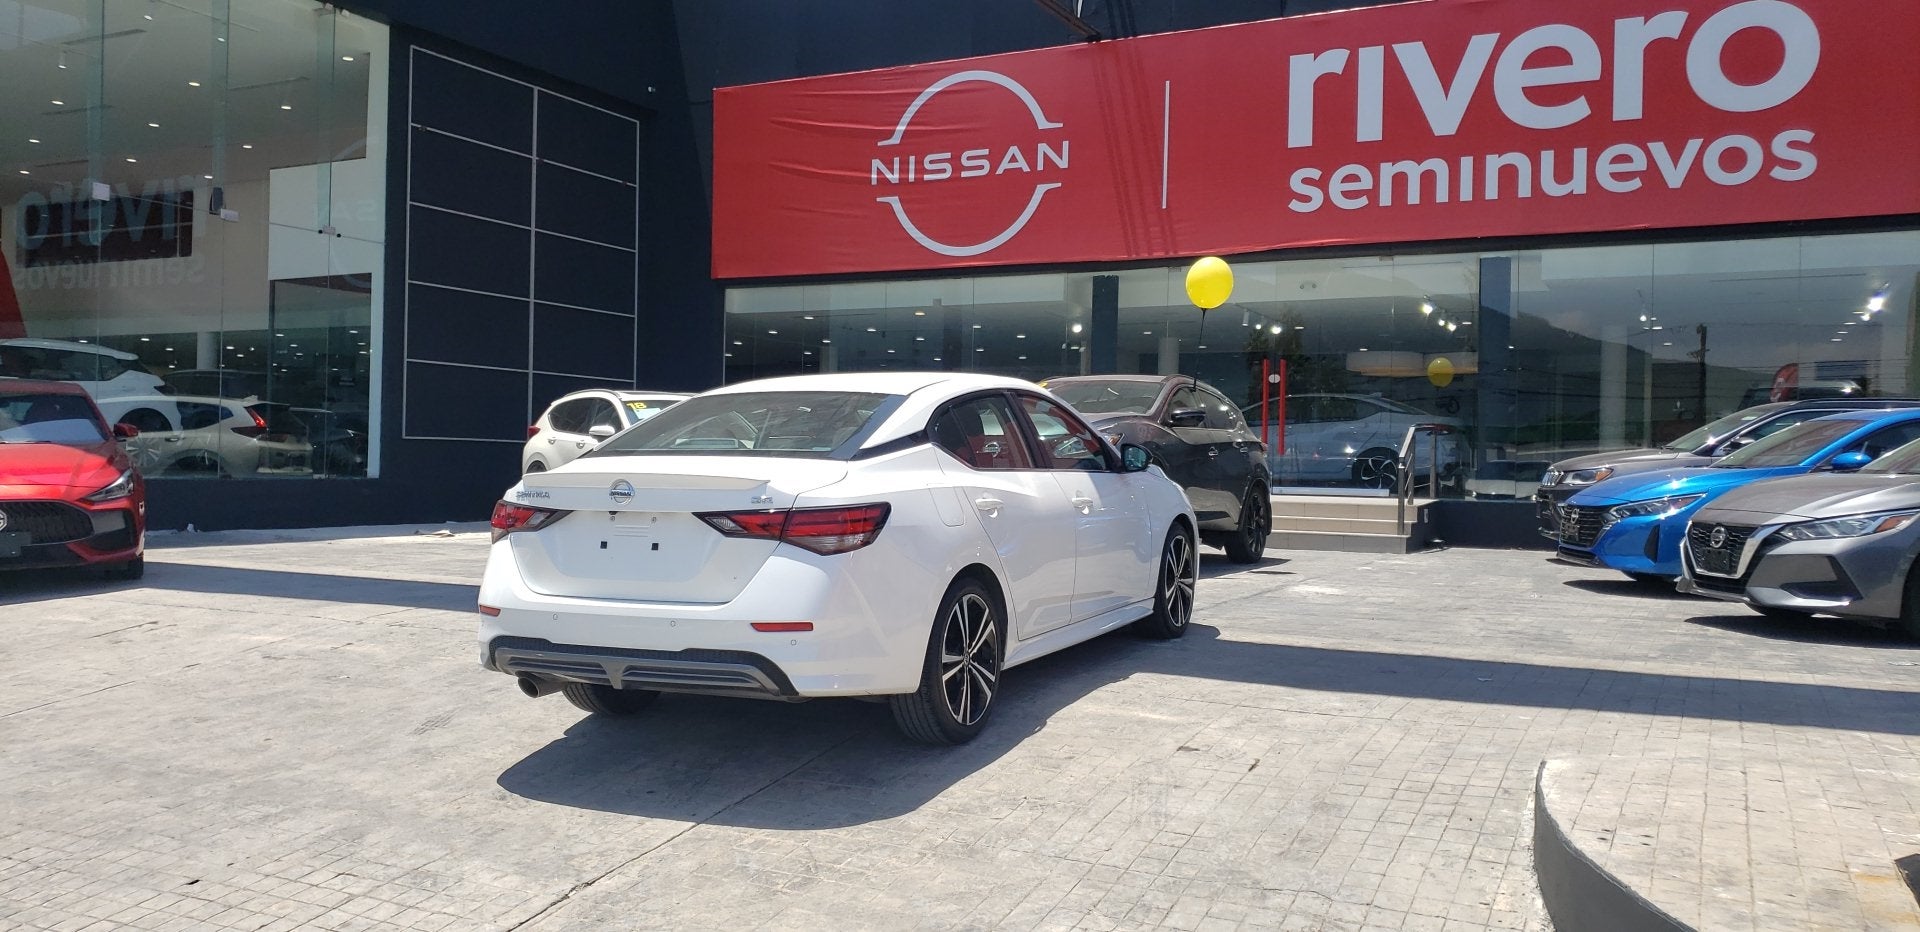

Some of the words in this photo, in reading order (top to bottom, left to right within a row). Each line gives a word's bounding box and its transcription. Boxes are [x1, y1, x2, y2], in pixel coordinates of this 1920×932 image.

[1287, 0, 1821, 149] rivero
[870, 138, 1070, 187] NISSAN
[1288, 129, 1817, 214] seminuevos
